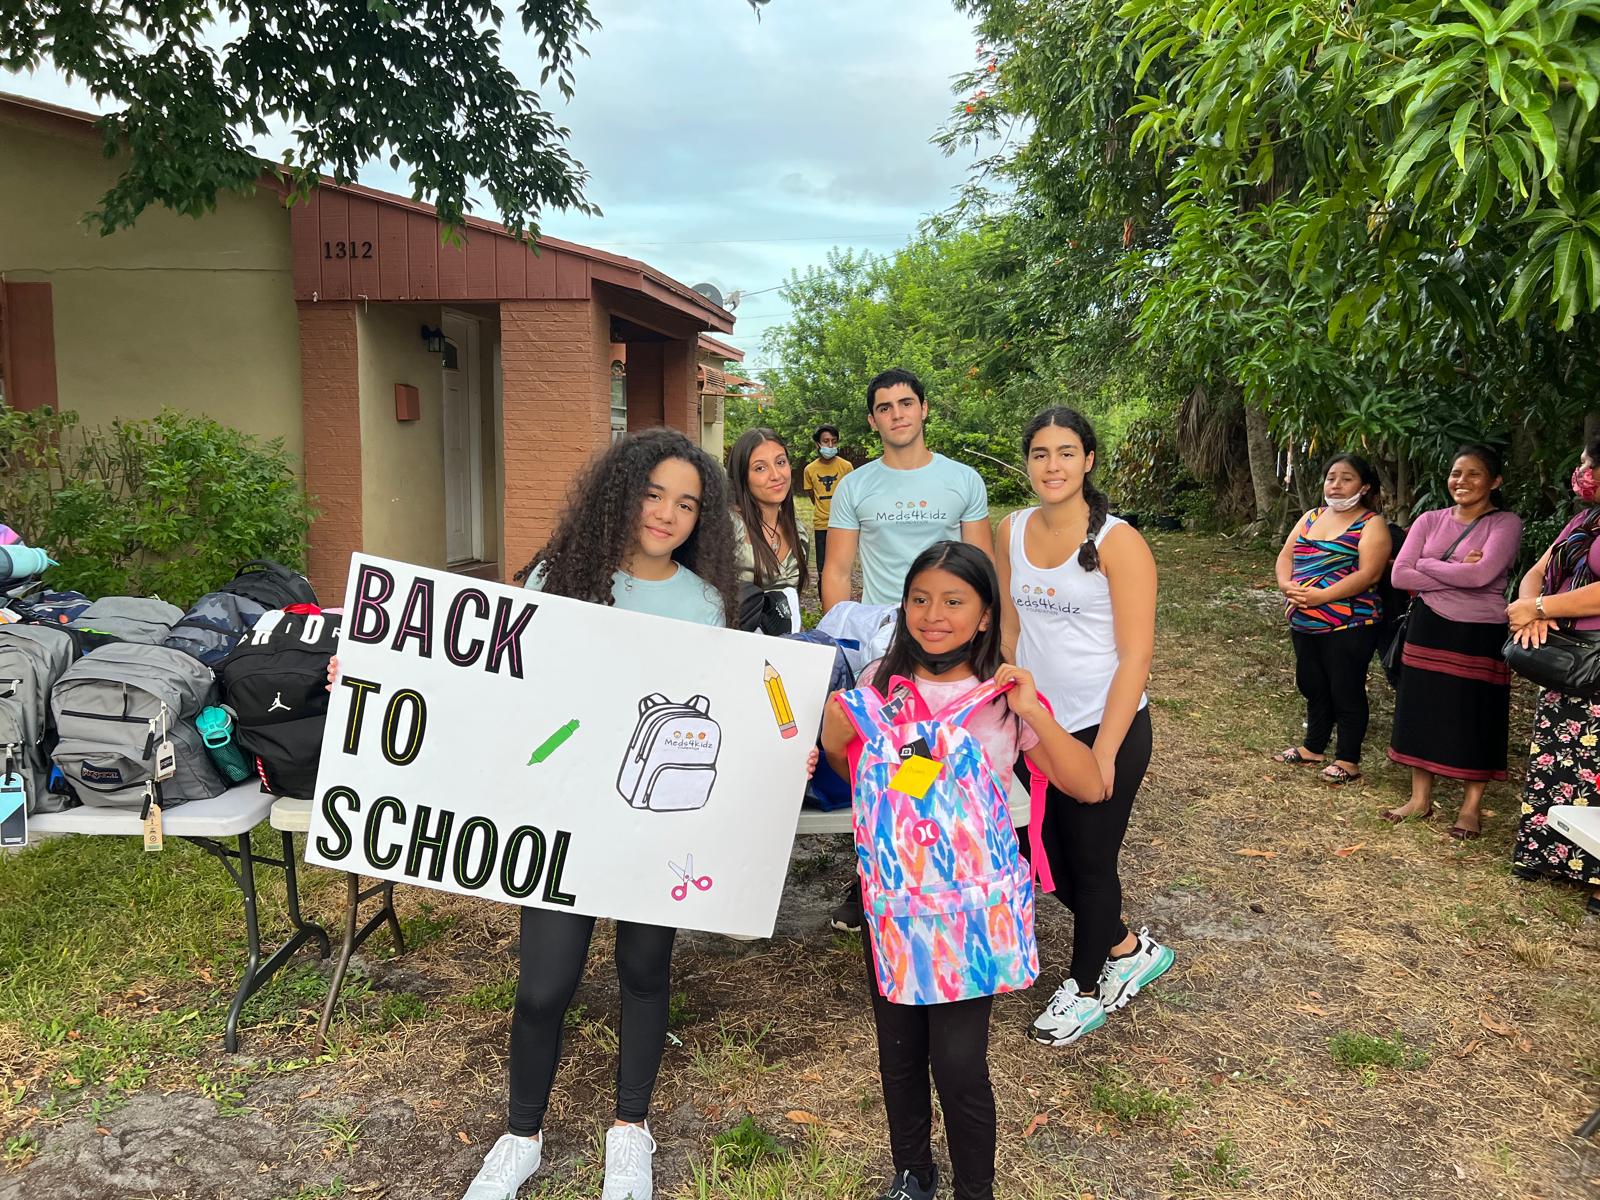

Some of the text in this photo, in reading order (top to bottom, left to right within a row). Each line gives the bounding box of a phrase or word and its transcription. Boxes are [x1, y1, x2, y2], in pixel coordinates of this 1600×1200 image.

[324, 241, 373, 259] 1312
[876, 508, 947, 521] Meds4kidz
[348, 563, 539, 680] BACK
[1013, 595, 1081, 614] eds4kidz
[341, 675, 427, 767] TO
[316, 785, 577, 907] SCHOOL
